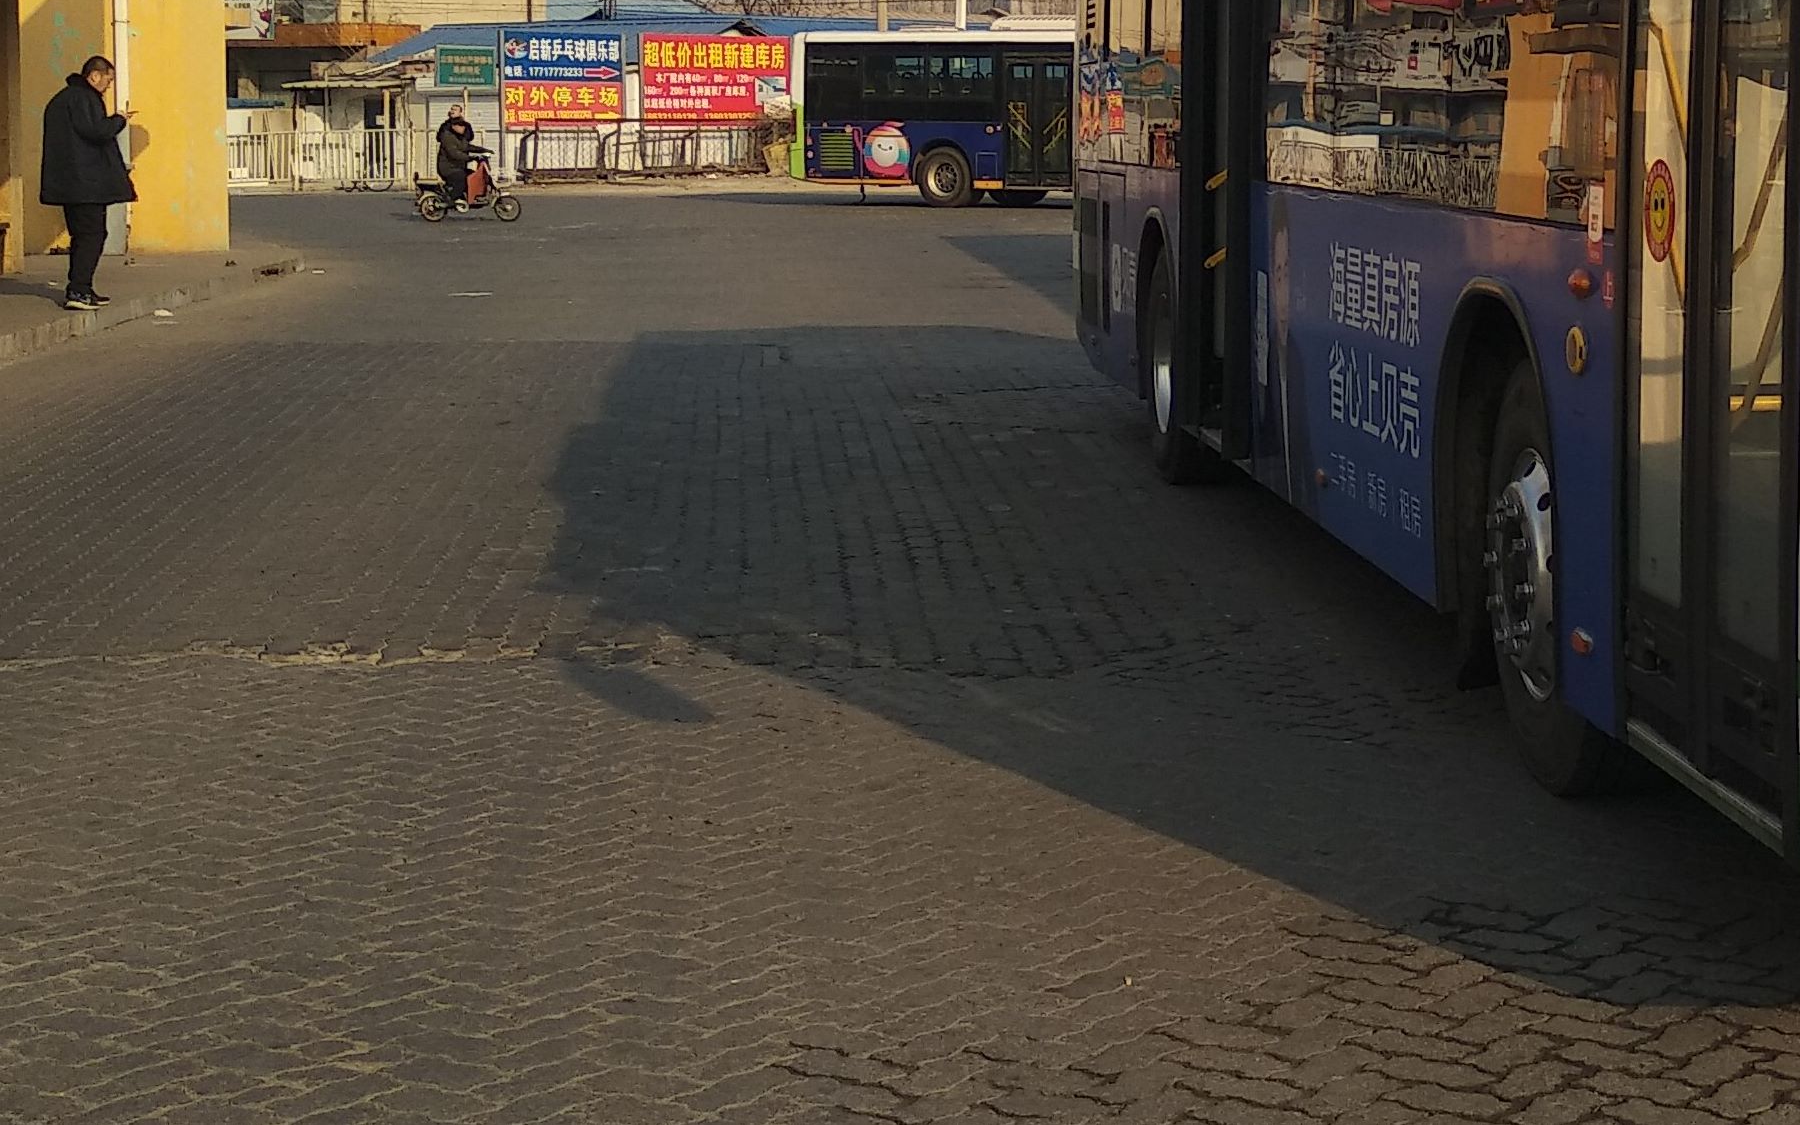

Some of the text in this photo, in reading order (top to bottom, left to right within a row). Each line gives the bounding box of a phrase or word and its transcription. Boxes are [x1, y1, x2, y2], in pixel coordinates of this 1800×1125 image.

[529, 38, 620, 62] 启新乒乓球俱乐部
[643, 41, 786, 70] 超低价出租新建库房
[505, 85, 620, 108] 对外停车场
[1328, 241, 1421, 348] 海量真房源
[1328, 340, 1421, 459] 省心上贝壳
